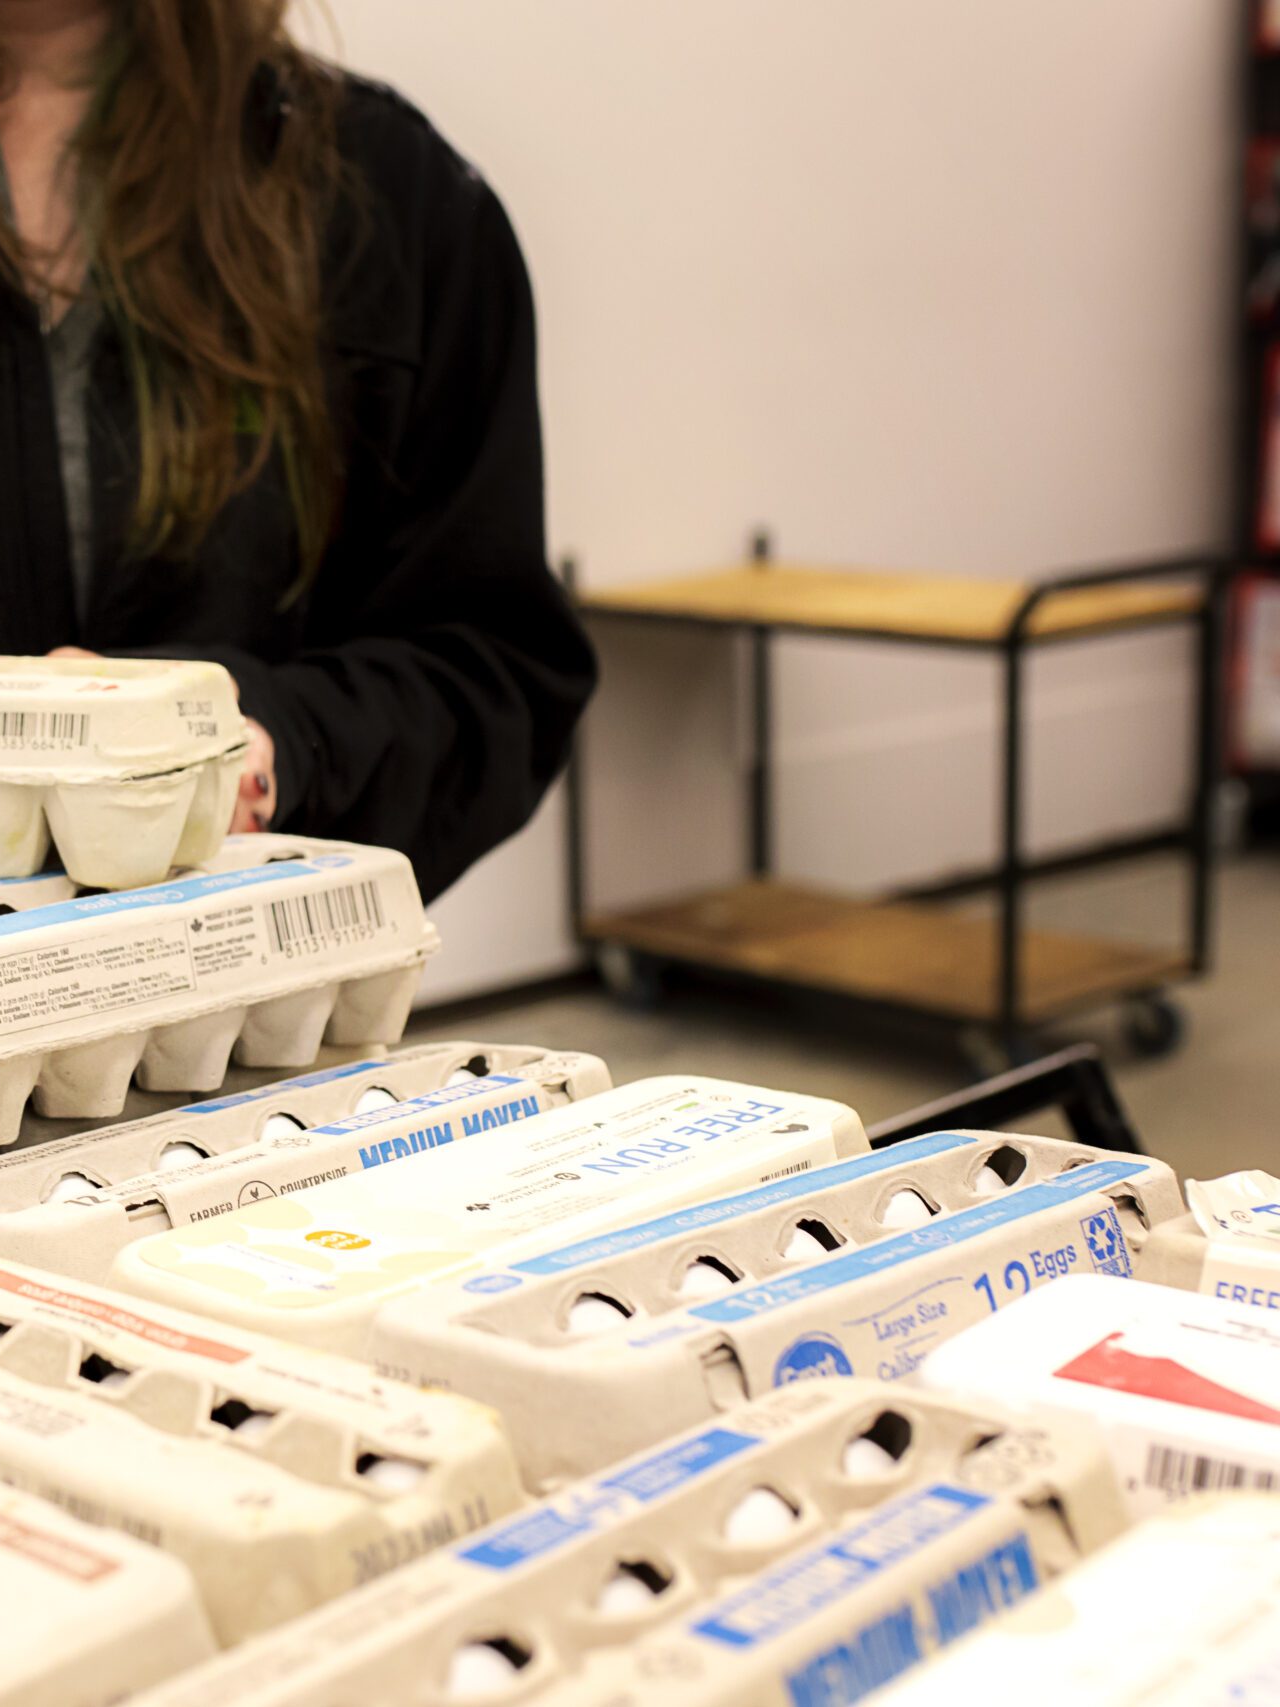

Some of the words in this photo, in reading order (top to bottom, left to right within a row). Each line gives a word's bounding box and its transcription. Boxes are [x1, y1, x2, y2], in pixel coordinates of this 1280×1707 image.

[31, 740, 73, 751] 66414
[37, 952, 59, 961] Calories
[285, 936, 328, 959] 81131
[334, 924, 375, 946] 91195
[48, 986, 69, 995] Calories
[358, 1122, 454, 1169] MEDIUM
[461, 1095, 540, 1137] MOYEN
[674, 1100, 785, 1141] FREE
[580, 1137, 691, 1175] RUN
[189, 1202, 234, 1224] FARMER
[279, 1166, 349, 1196] COUNTRYSIDE
[973, 1260, 1032, 1313] 12
[1029, 1242, 1077, 1280] Eggs
[874, 1313, 916, 1343] Large
[915, 1300, 950, 1331] Size
